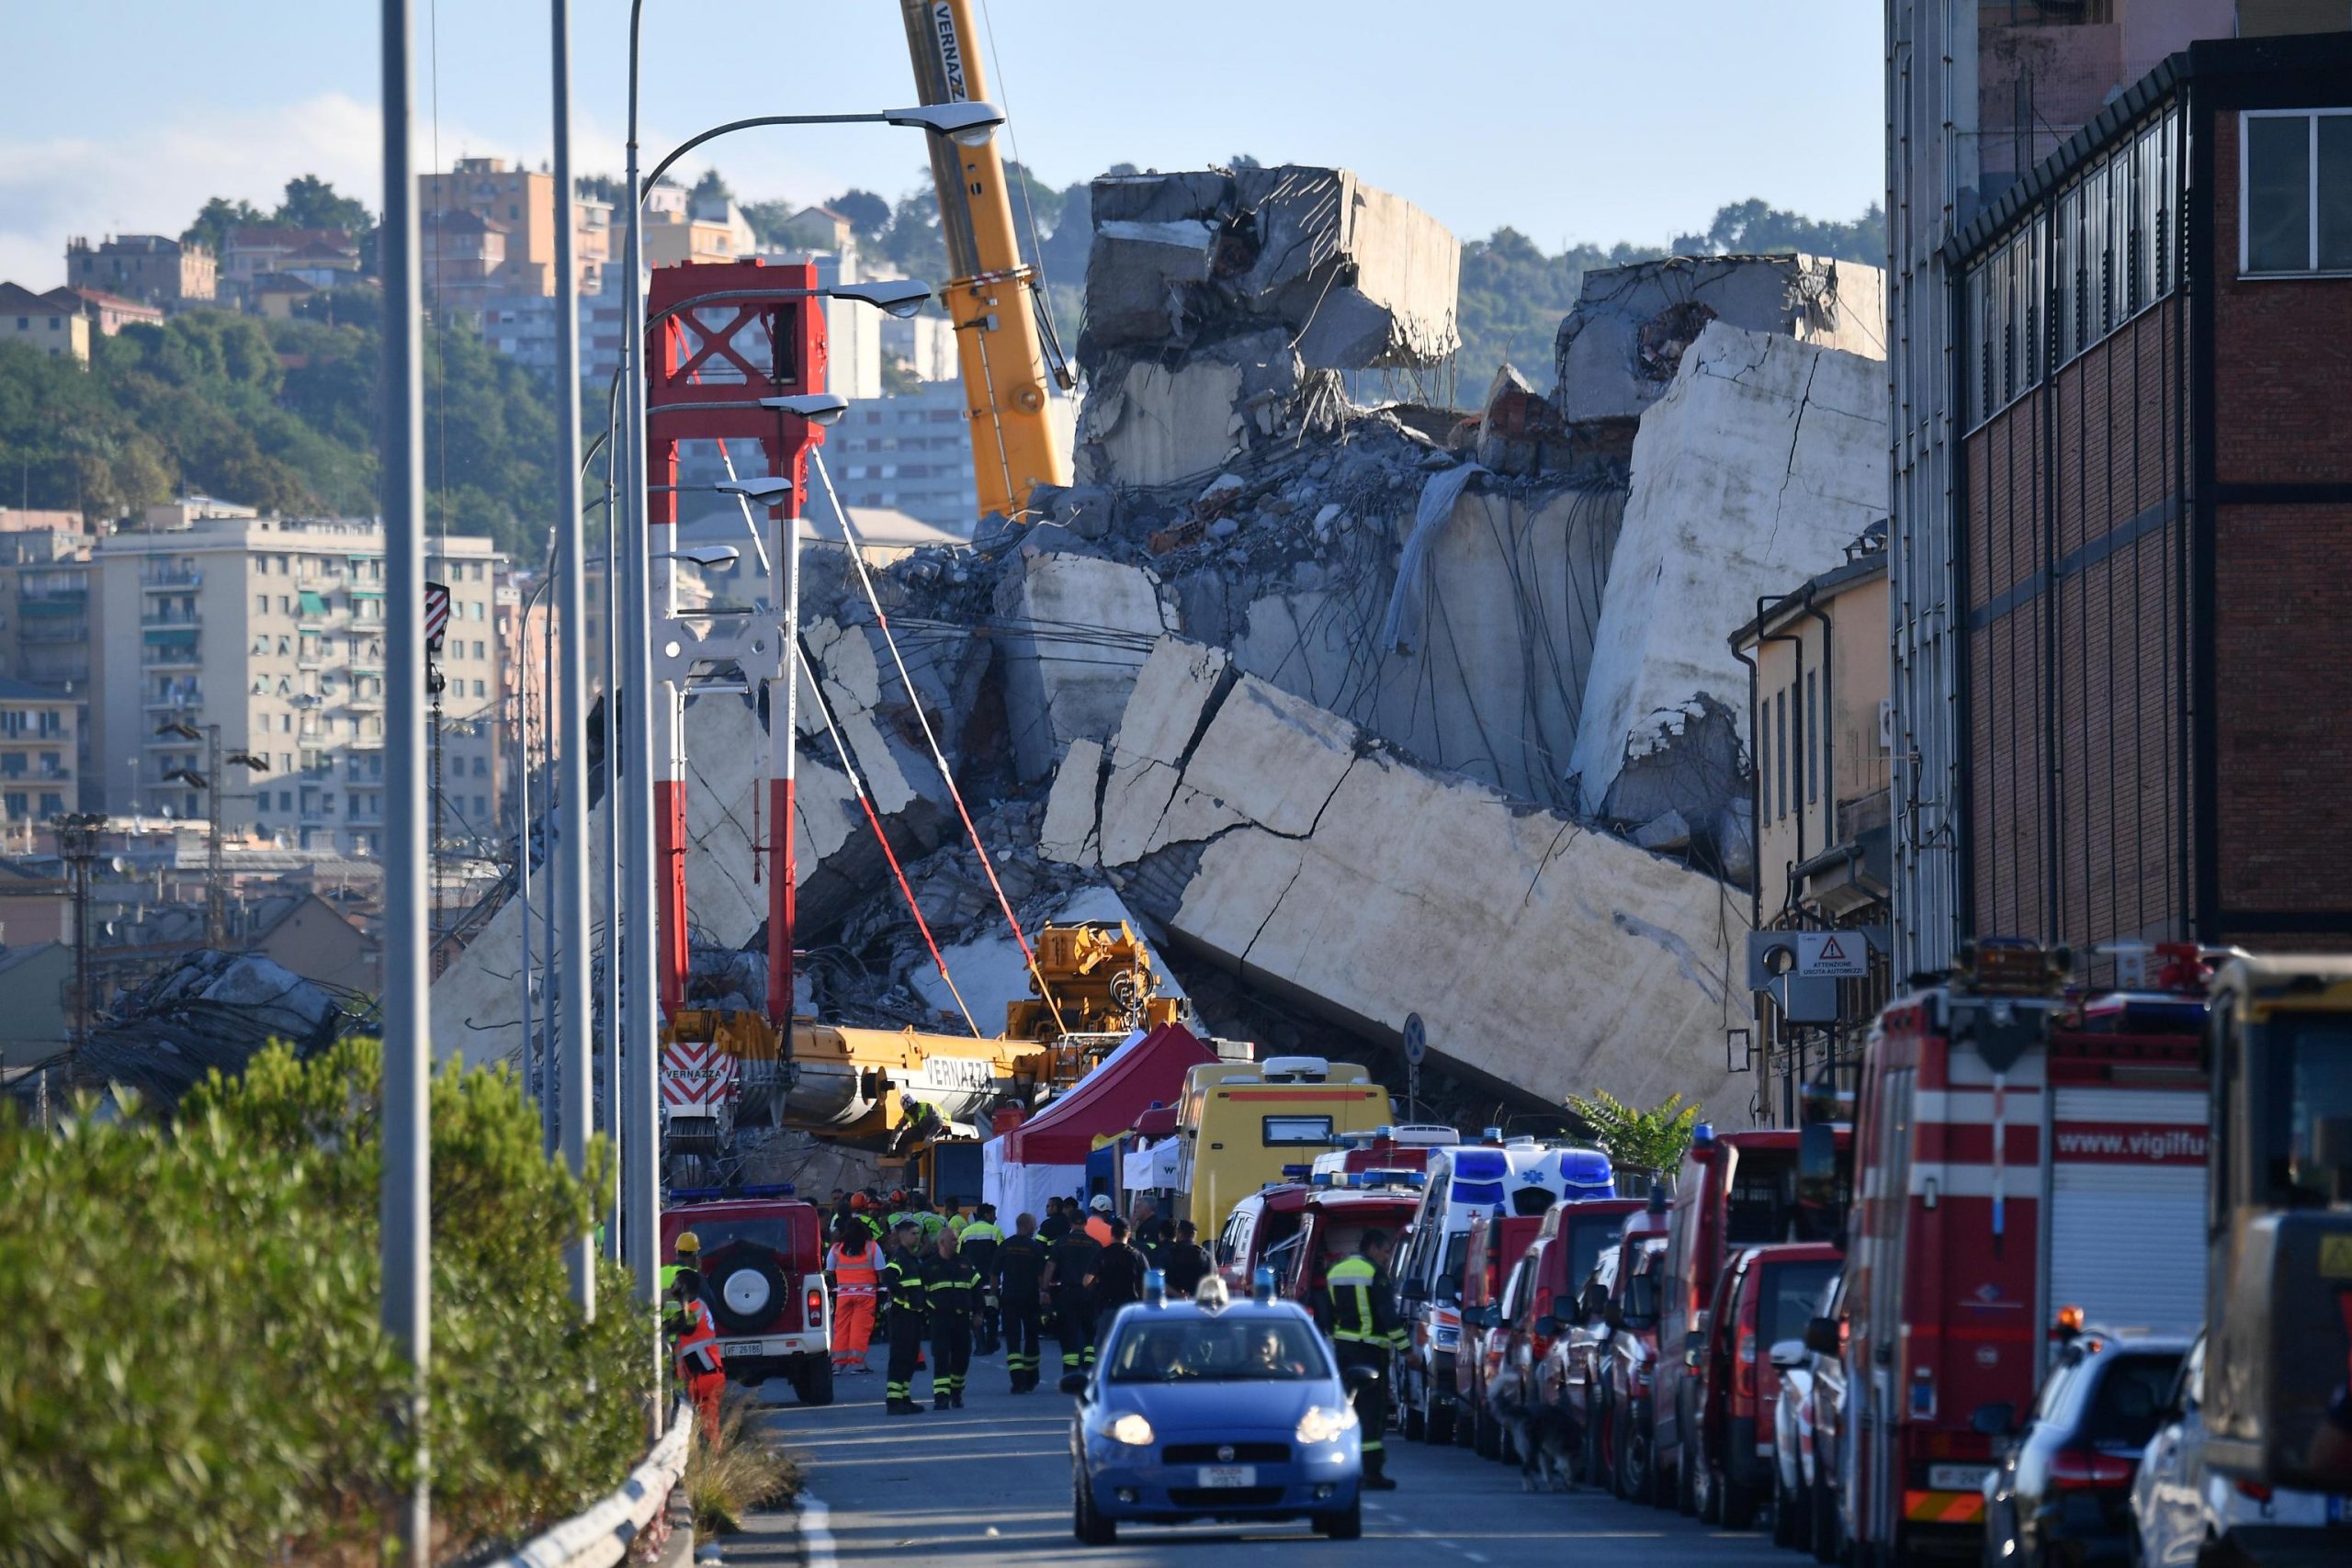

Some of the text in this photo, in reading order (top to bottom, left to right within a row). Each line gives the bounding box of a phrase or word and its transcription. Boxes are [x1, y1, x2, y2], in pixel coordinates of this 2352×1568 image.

[935, 6, 966, 103] VERNAZZ
[666, 1070, 721, 1078] VERNAZZA
[925, 1058, 993, 1089] VERNAZZA
[2057, 1131, 2209, 1160] www.vigilfu
